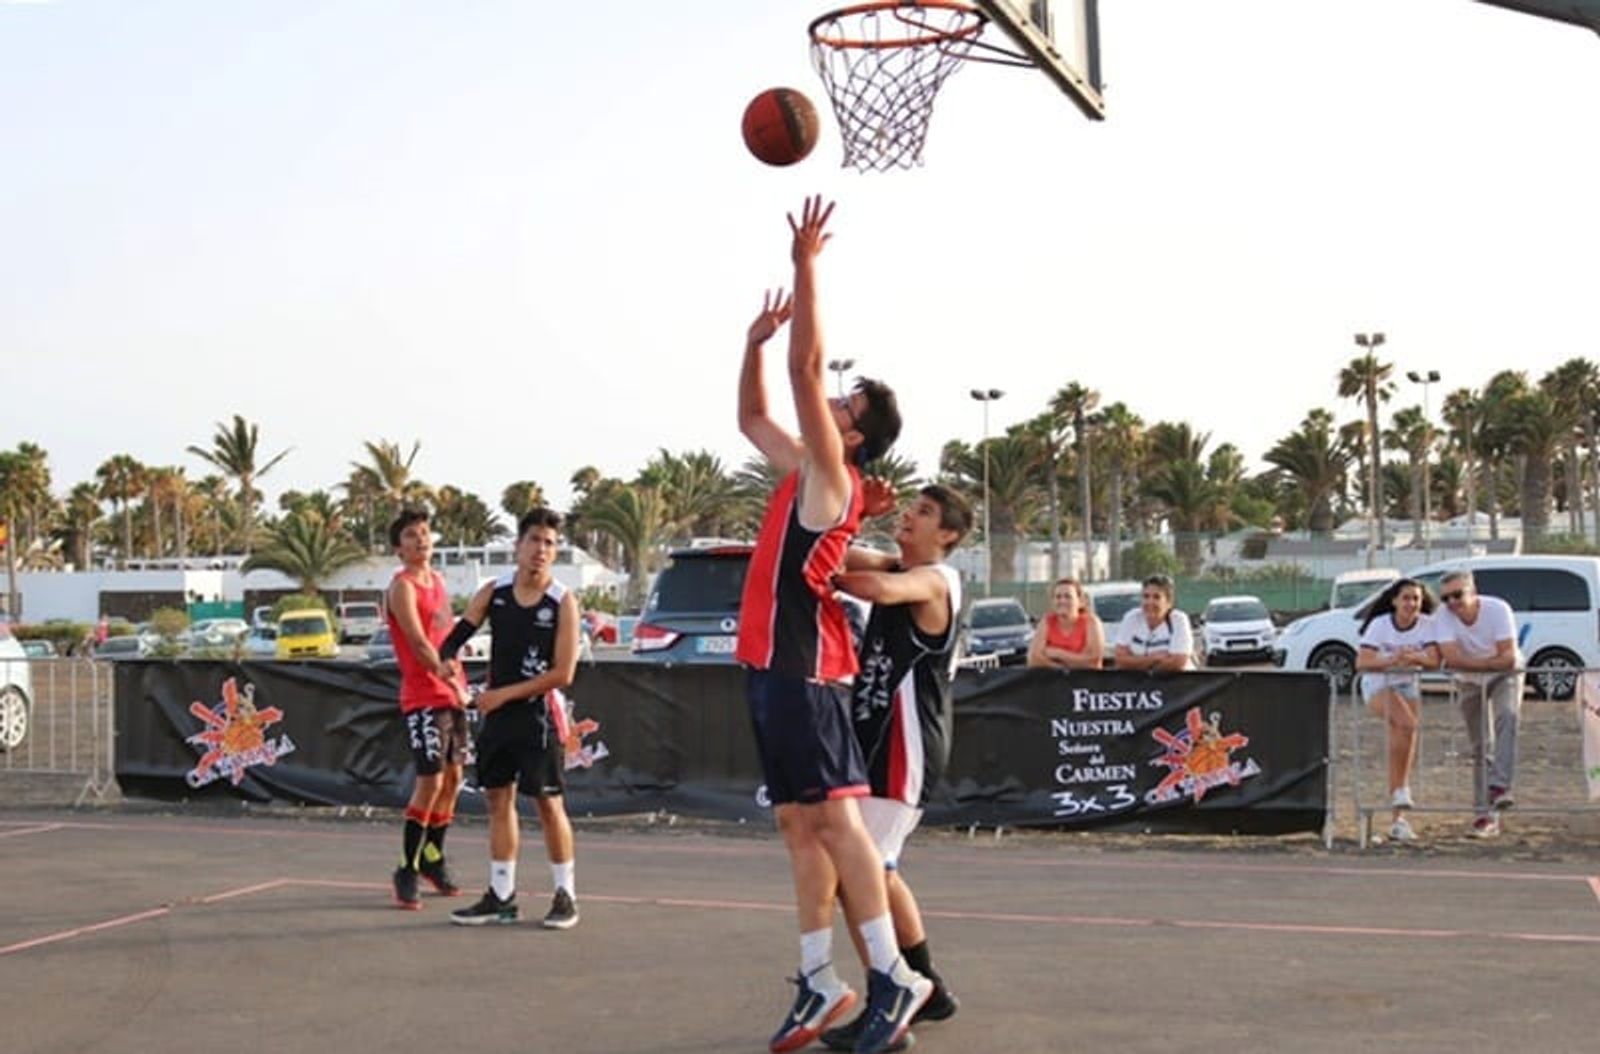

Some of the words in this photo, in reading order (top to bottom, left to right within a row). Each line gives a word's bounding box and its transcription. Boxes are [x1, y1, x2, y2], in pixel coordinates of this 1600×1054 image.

[1072, 688, 1163, 712] FIESTAS
[1051, 718, 1135, 738] NUESTRA
[1055, 763, 1136, 784] CARMEN
